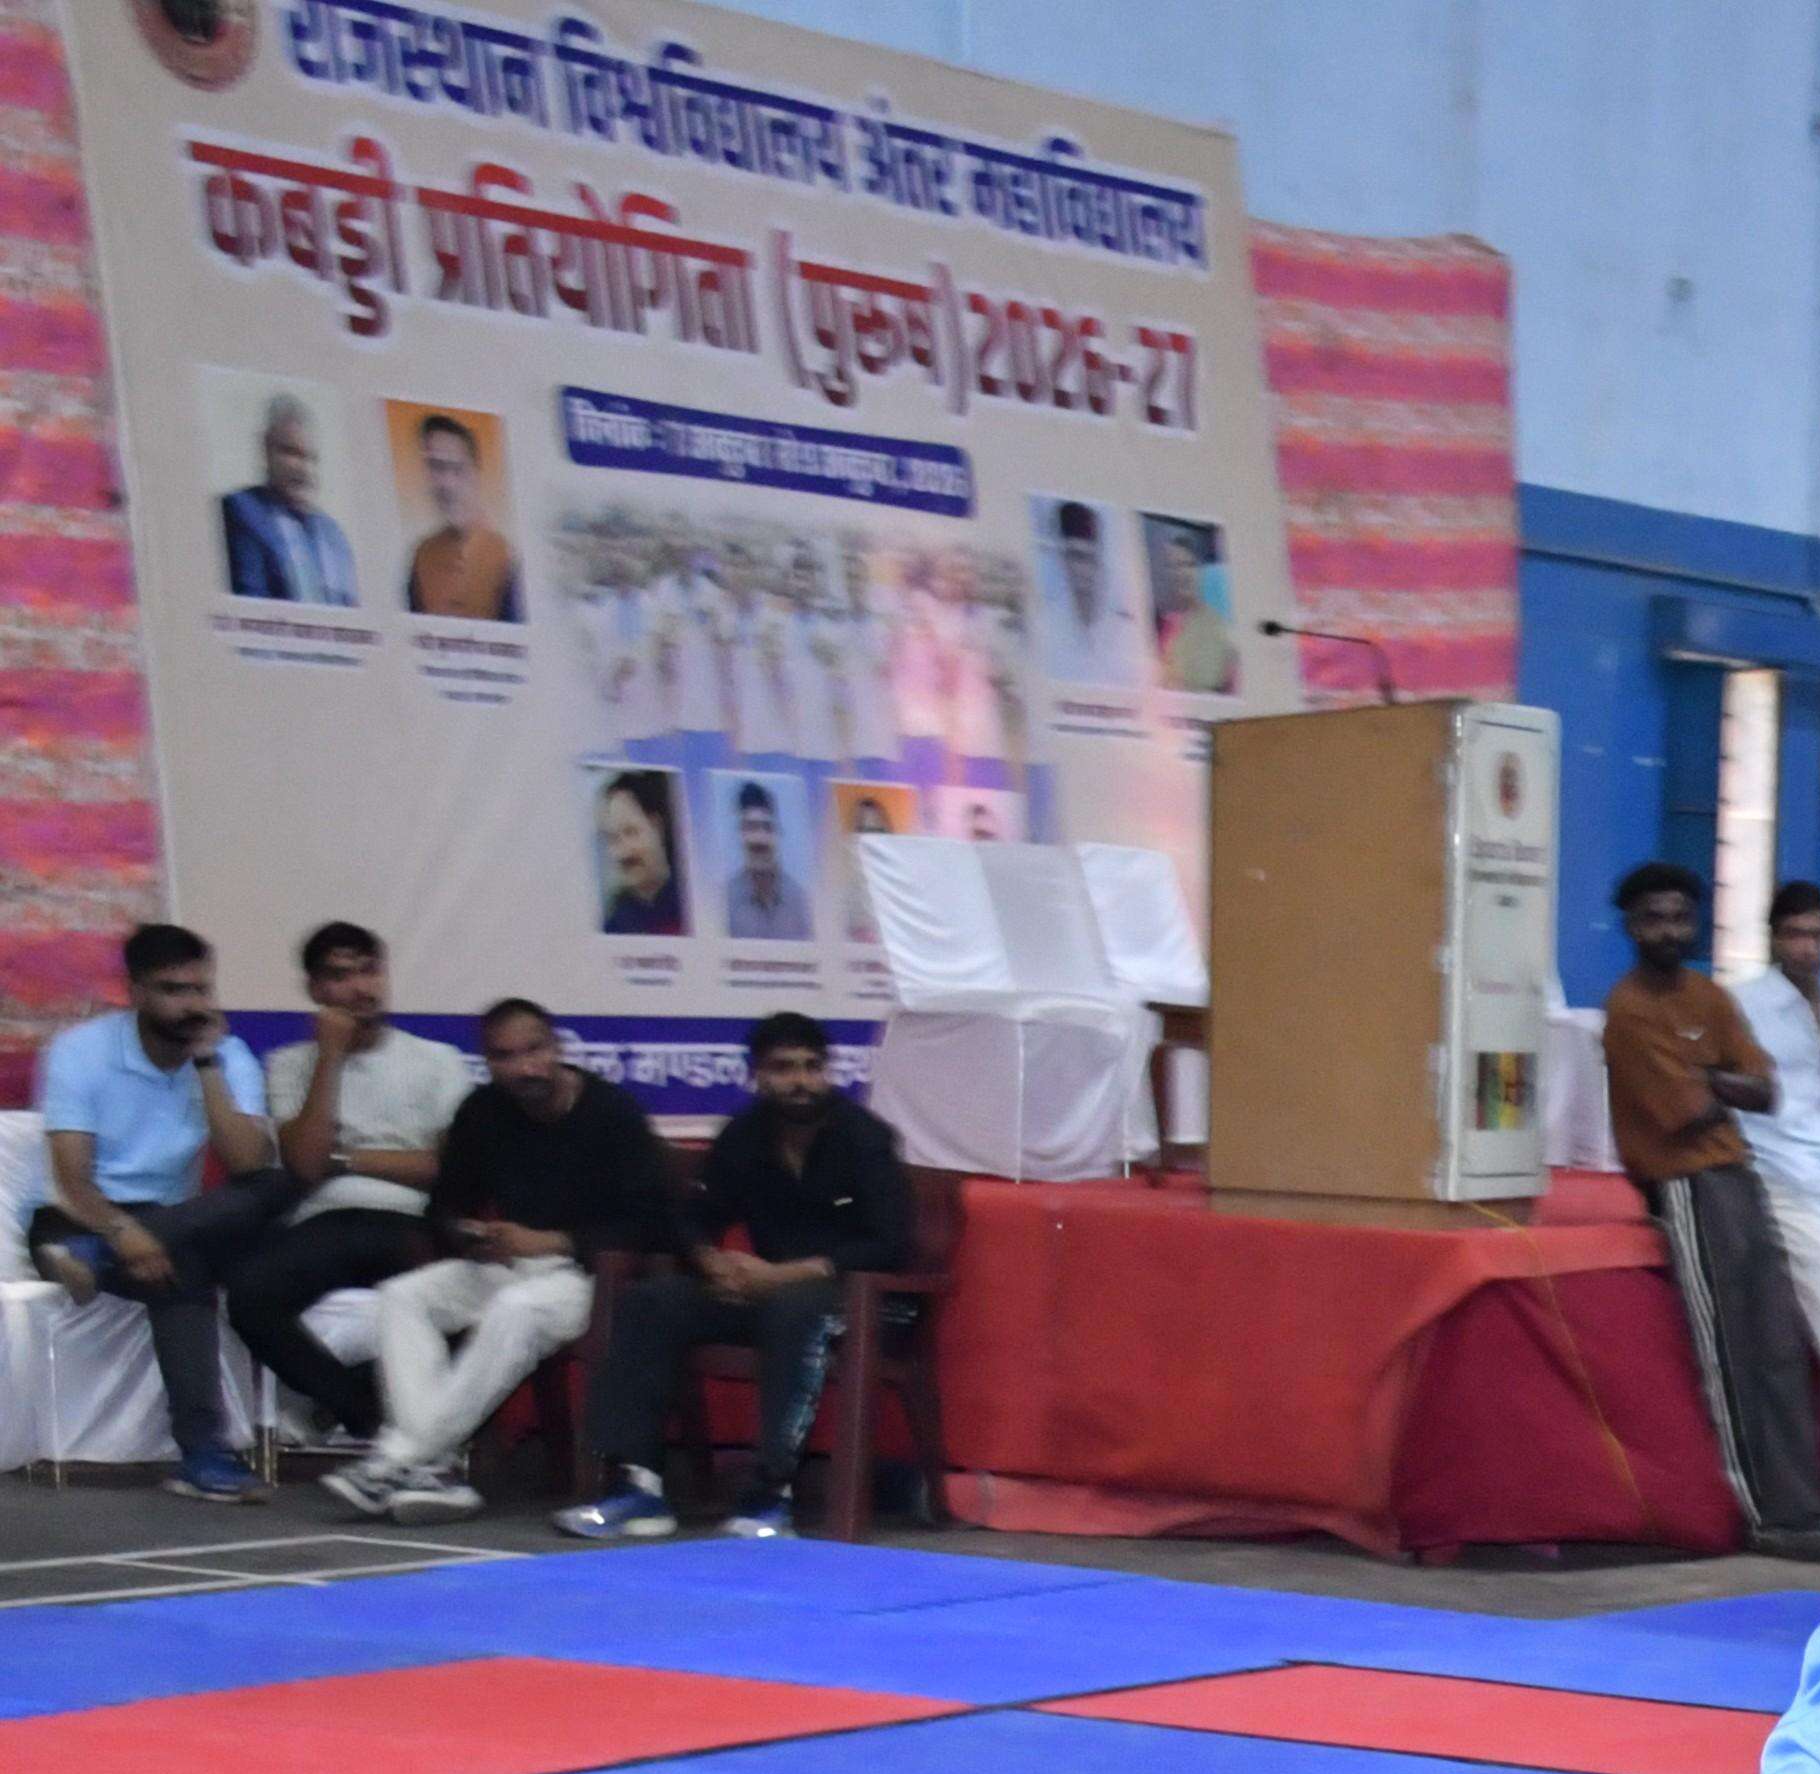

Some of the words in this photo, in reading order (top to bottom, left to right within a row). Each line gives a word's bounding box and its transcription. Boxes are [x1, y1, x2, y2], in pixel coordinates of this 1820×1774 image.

[285, 0, 551, 128] राजस्थान
[187, 134, 410, 337] कबड्डी
[416, 162, 760, 355] प्रतियोगिता
